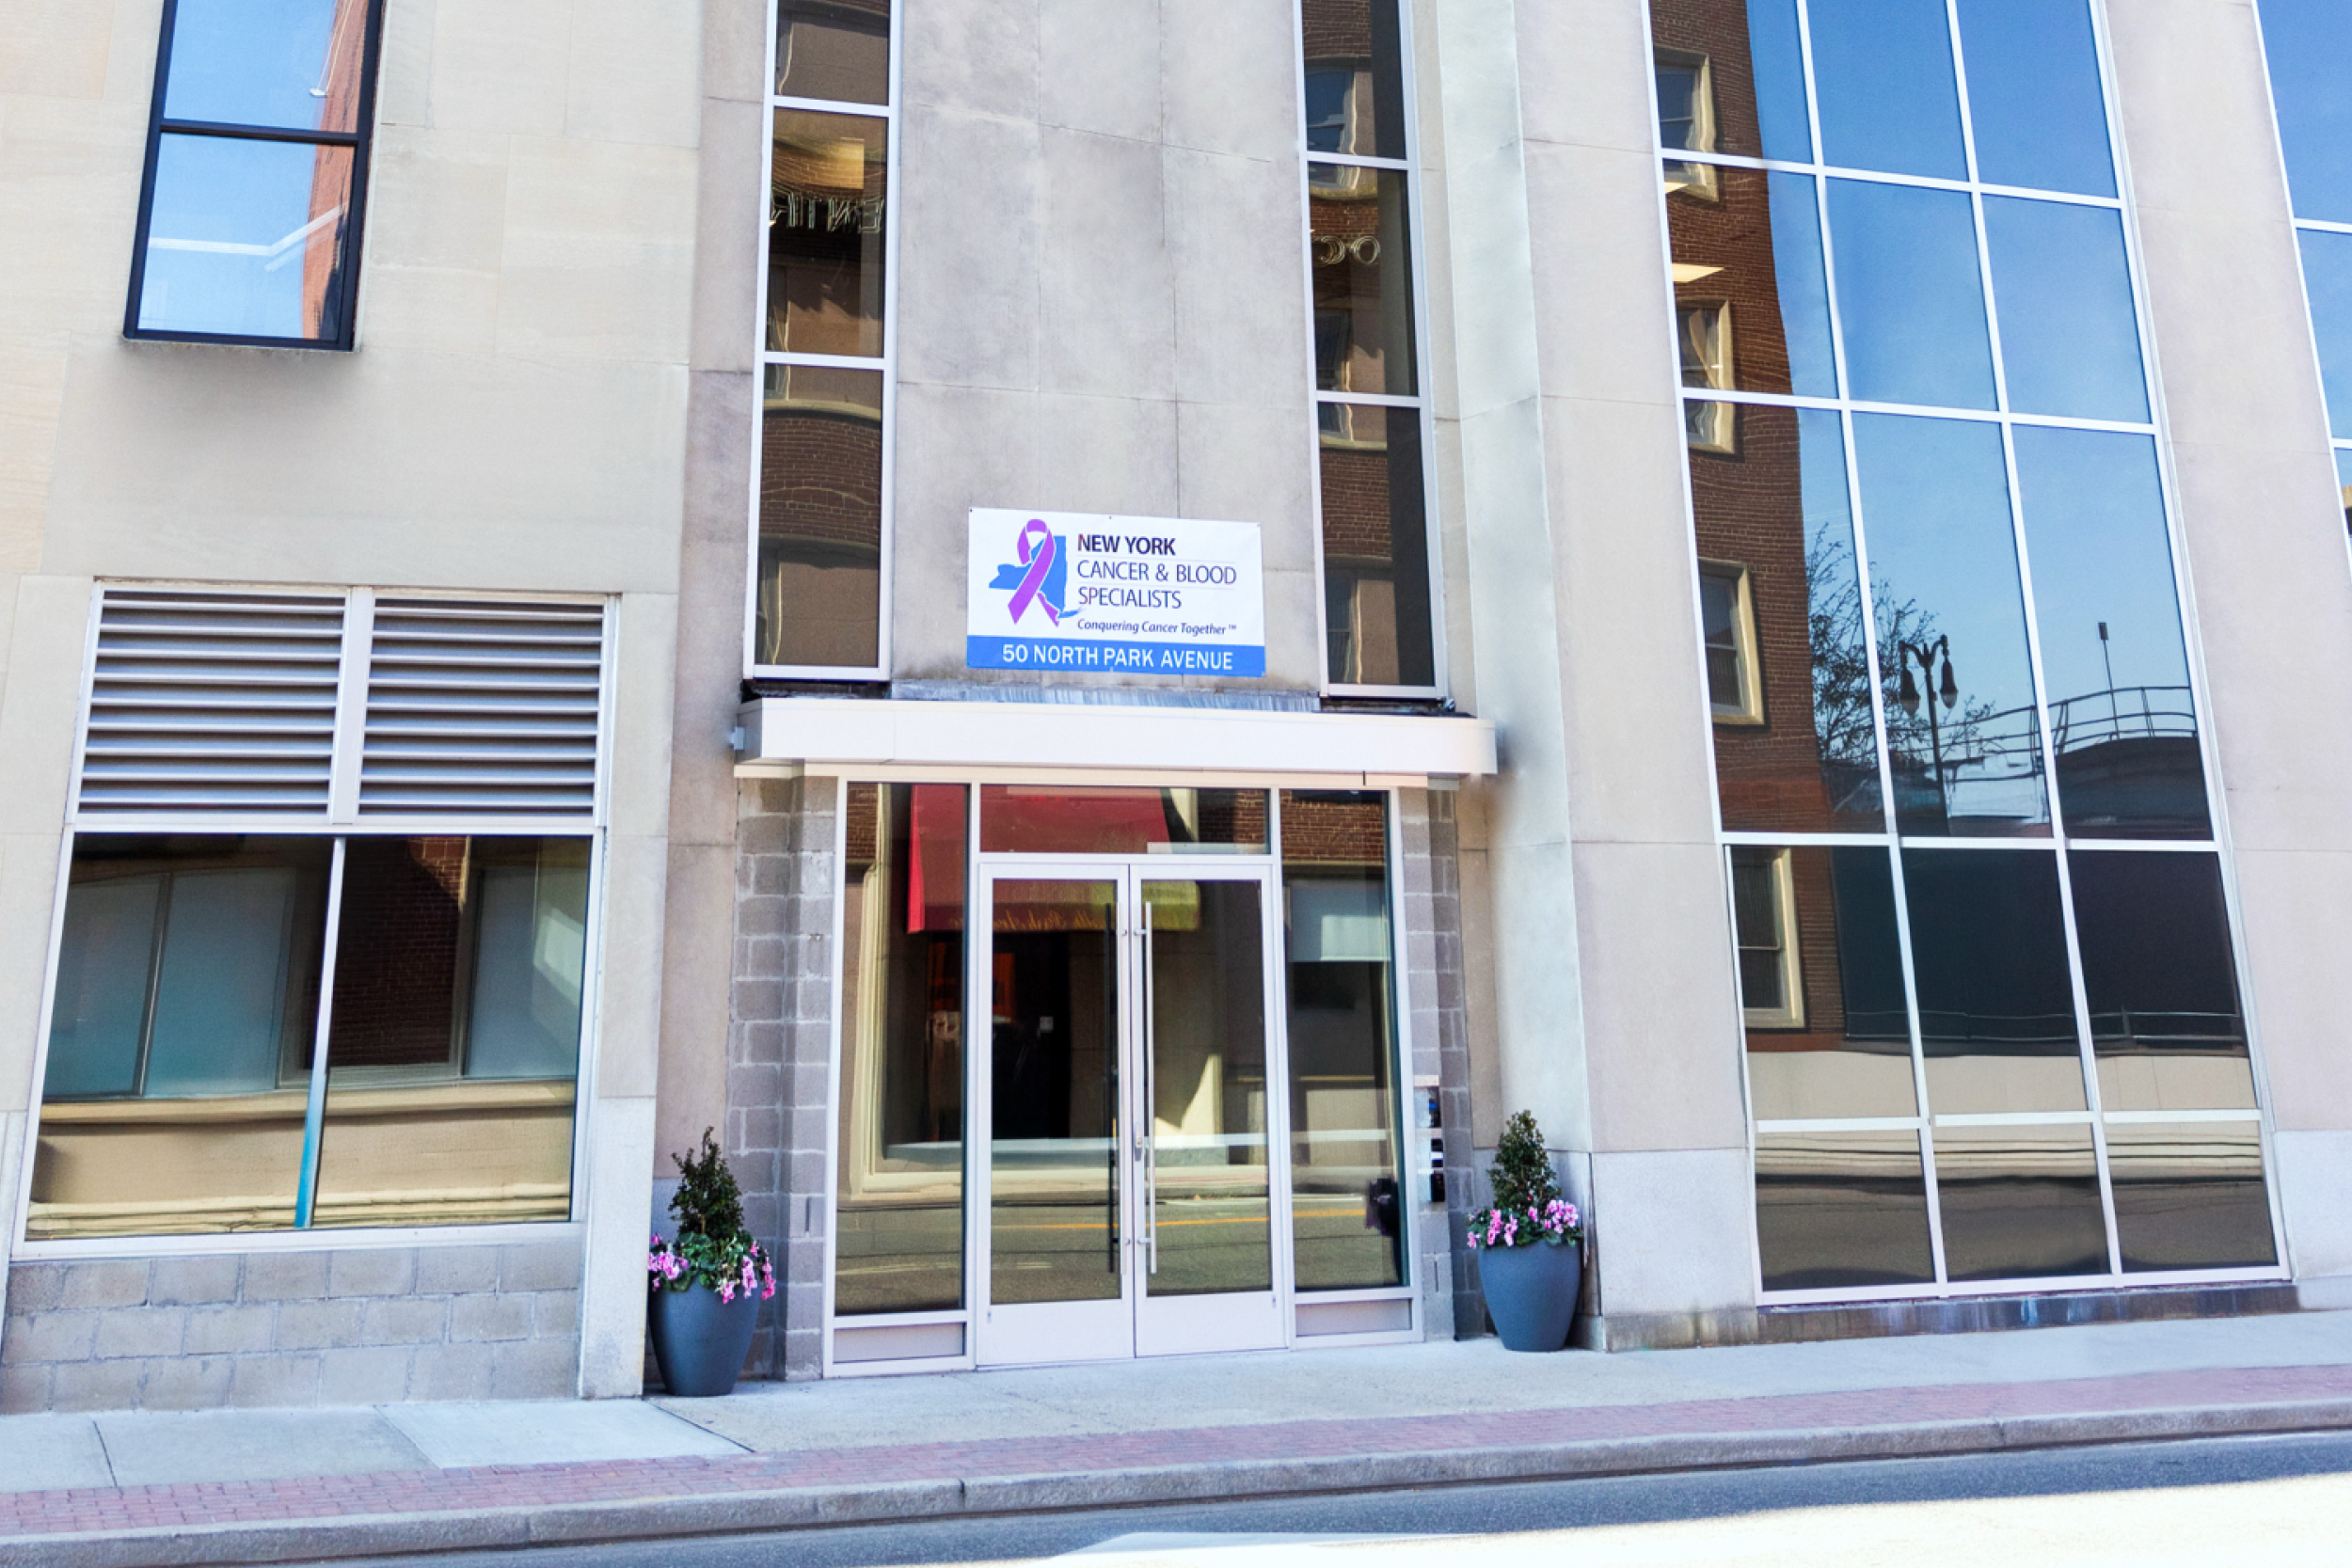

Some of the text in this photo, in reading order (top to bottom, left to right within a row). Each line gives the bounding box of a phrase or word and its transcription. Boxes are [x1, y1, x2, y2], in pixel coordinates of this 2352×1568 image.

[1077, 532, 1176, 556] NEW YORK
[1076, 559, 1237, 585] CANCER & BLOOD
[1077, 586, 1183, 609] SPECIALISTS
[1076, 617, 1139, 634] Conquering
[1141, 620, 1179, 633] Cancer
[1181, 622, 1227, 637] Together
[1002, 643, 1234, 671] 50 NORTH PARK AVENUE
